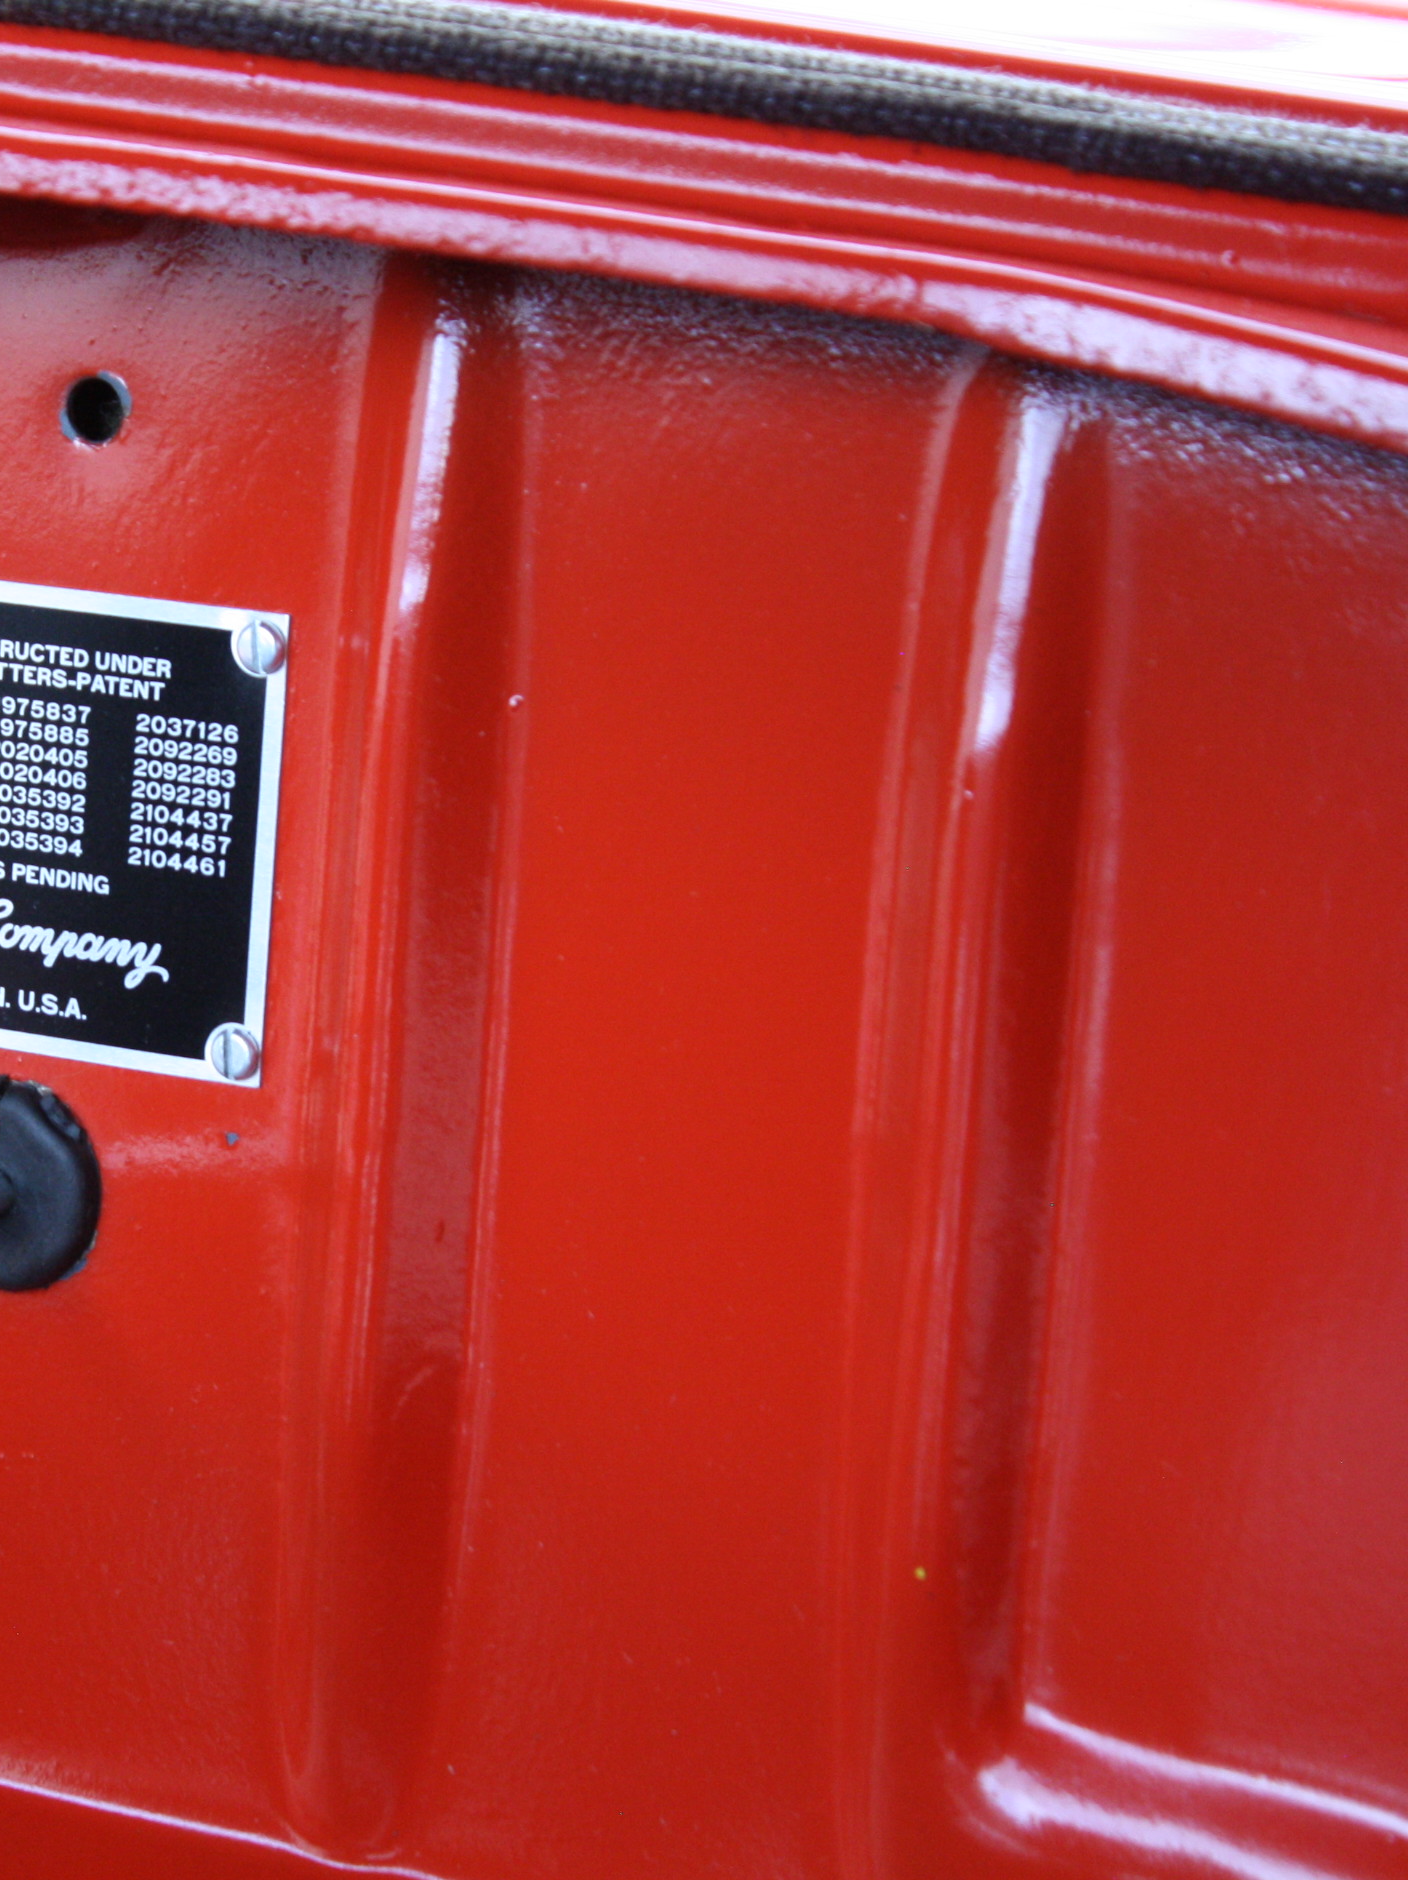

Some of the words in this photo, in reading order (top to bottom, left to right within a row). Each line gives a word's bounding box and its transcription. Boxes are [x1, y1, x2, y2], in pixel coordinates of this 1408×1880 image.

[95, 651, 171, 678] UNDER
[136, 714, 239, 743] 2037126
[134, 736, 237, 766] 2092269
[133, 758, 236, 788] 2092283
[132, 780, 230, 810] 2092291
[130, 802, 233, 832] 2104437
[129, 824, 231, 854] 2104457
[128, 847, 226, 877] 2104461
[12, 863, 109, 894] PENDING
[18, 990, 86, 1020] U.S.A.
